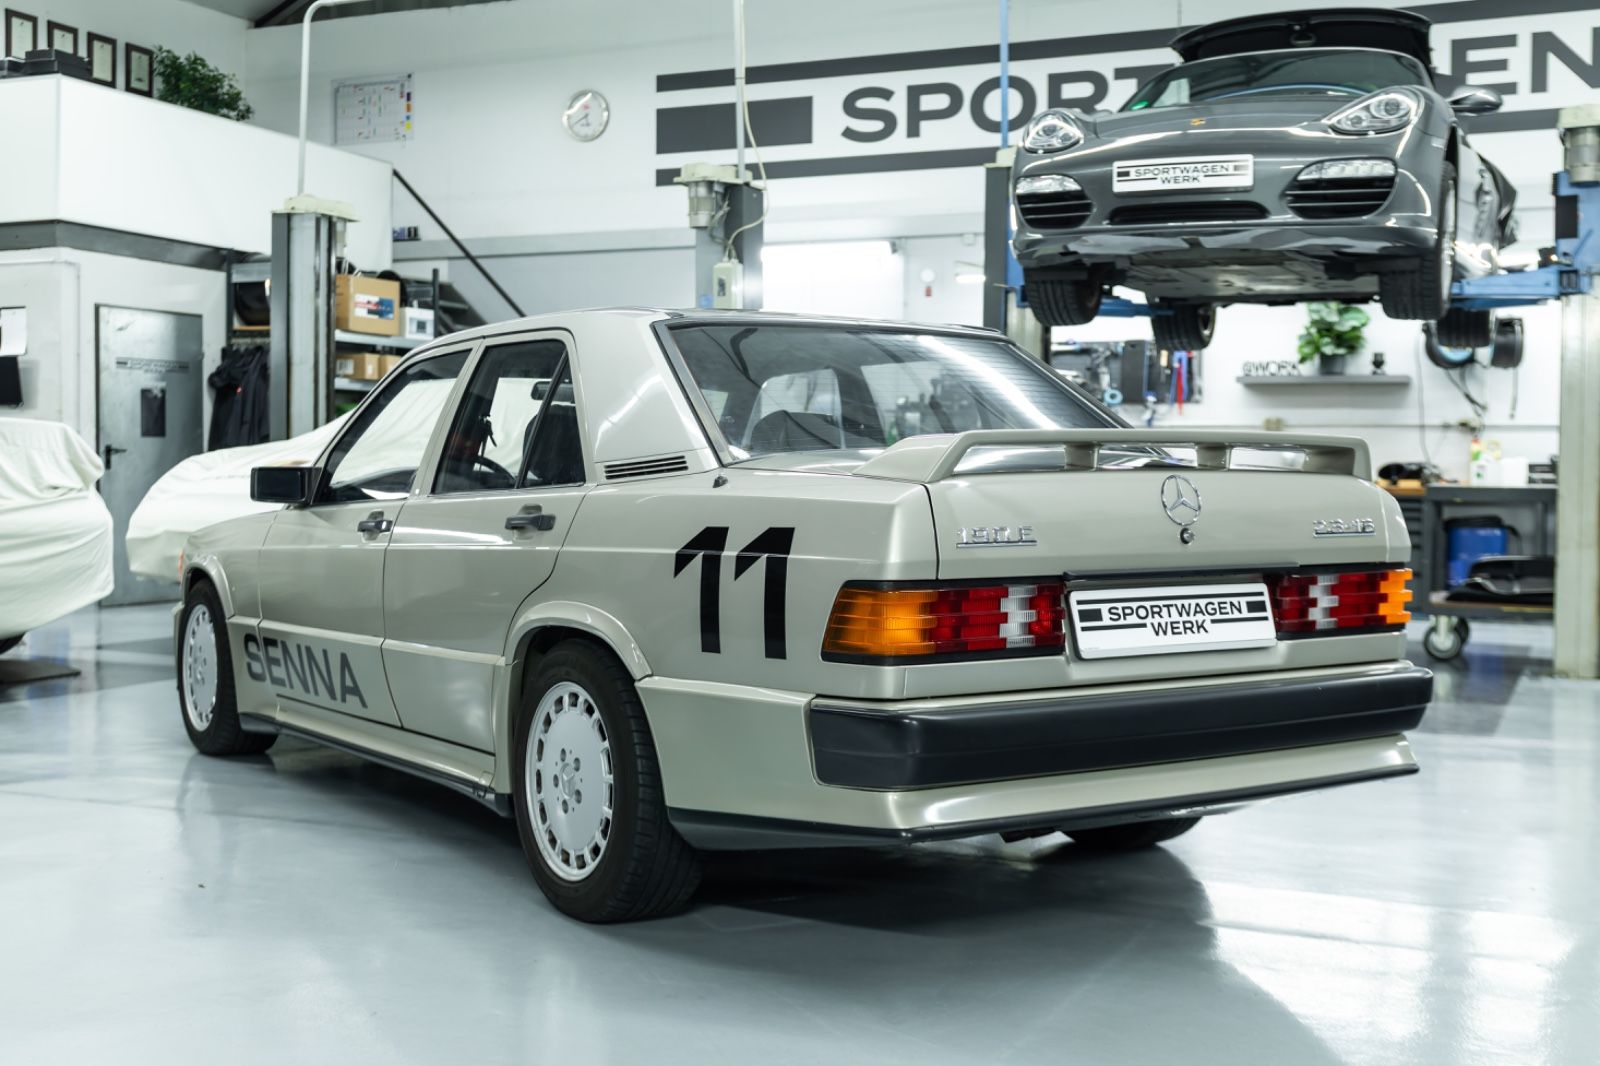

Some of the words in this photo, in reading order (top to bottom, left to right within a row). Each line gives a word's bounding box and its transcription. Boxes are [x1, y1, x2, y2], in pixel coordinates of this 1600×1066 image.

[1134, 164, 1230, 177] SPORTWAGEN
[1160, 175, 1201, 184] WERK
[673, 526, 796, 660] 11
[1108, 600, 1243, 622] SPORTWAGEN
[1150, 619, 1209, 637] WERK
[243, 632, 368, 709] SENNA
